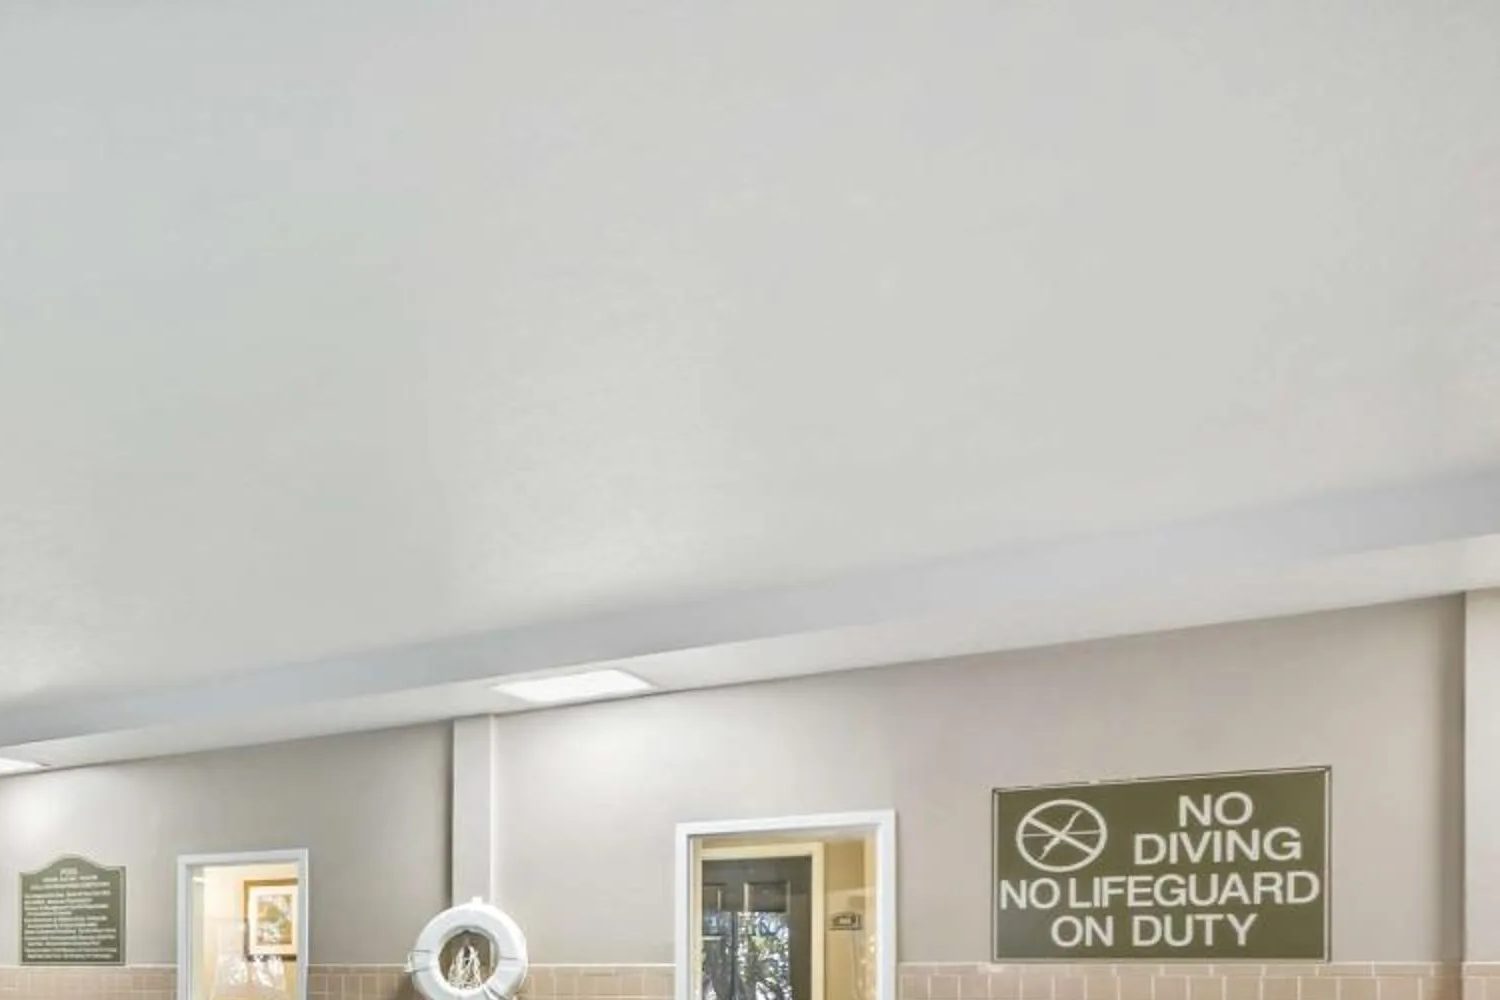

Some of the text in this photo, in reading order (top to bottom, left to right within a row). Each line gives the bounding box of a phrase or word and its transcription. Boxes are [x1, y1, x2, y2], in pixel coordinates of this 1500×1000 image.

[1178, 791, 1254, 827] NO
[1133, 827, 1302, 865] DIVING
[1000, 870, 1321, 910] NO LIFEGUARD
[1050, 912, 1258, 948] ON DUTY
